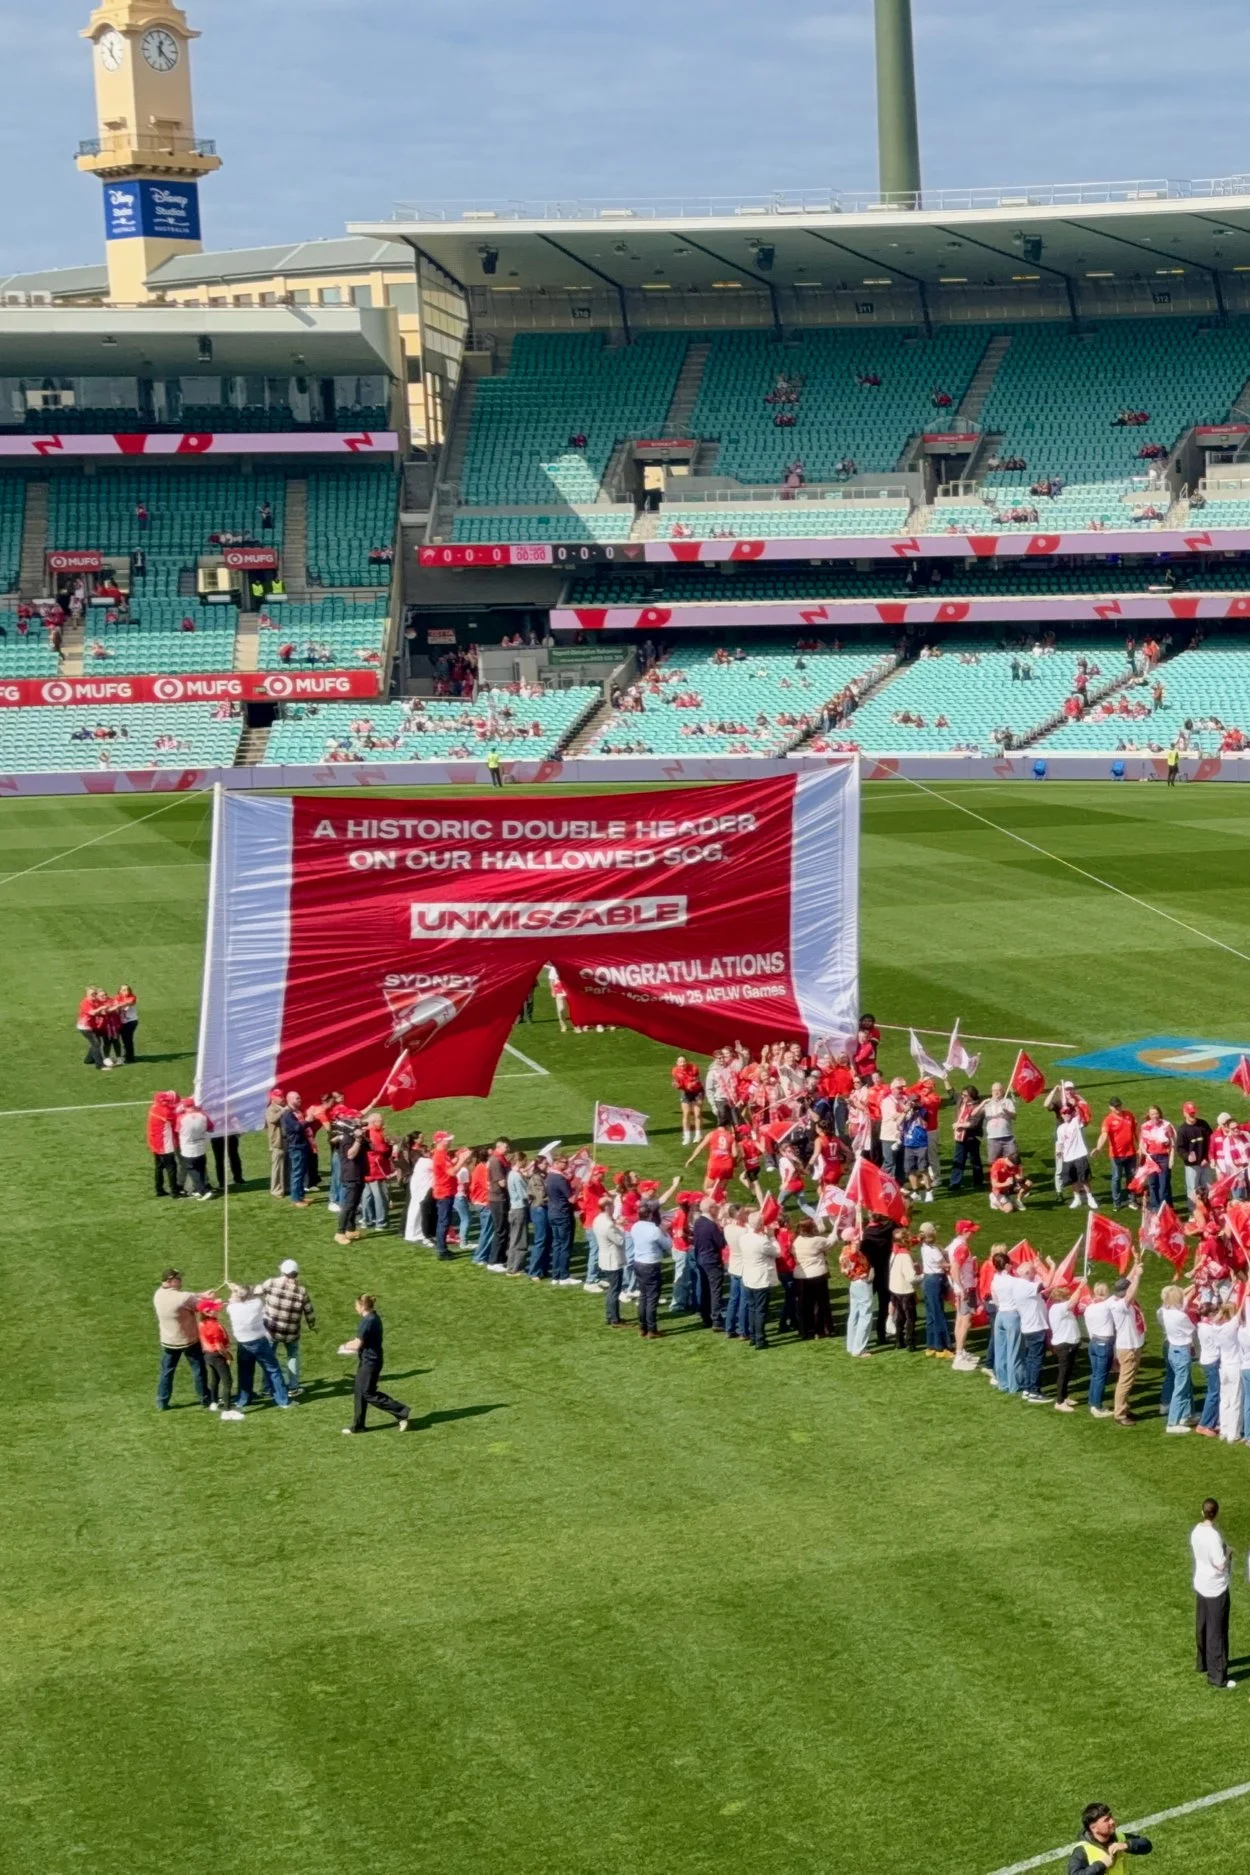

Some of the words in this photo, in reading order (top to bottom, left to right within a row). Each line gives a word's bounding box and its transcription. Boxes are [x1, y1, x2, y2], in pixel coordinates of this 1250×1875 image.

[67, 556, 99, 567] MUFG
[244, 553, 275, 564] MUFG
[516, 551, 546, 561] 00:00
[76, 682, 132, 699] MUFG
[186, 679, 243, 695] MUFG
[296, 677, 350, 693] MUFG
[314, 819, 336, 839] A
[347, 819, 493, 840] HISTORIC
[502, 819, 626, 840] DOUBLE
[636, 813, 757, 839] HEADER
[349, 850, 396, 870] ON
[405, 850, 472, 870] OUR
[481, 850, 656, 870] HALLOWED
[417, 903, 679, 932] UNMISSABLE
[383, 974, 480, 989] SYDNEY
[686, 990, 703, 1004] 25
[706, 988, 740, 1003] AFLW
[742, 984, 786, 999] Games
